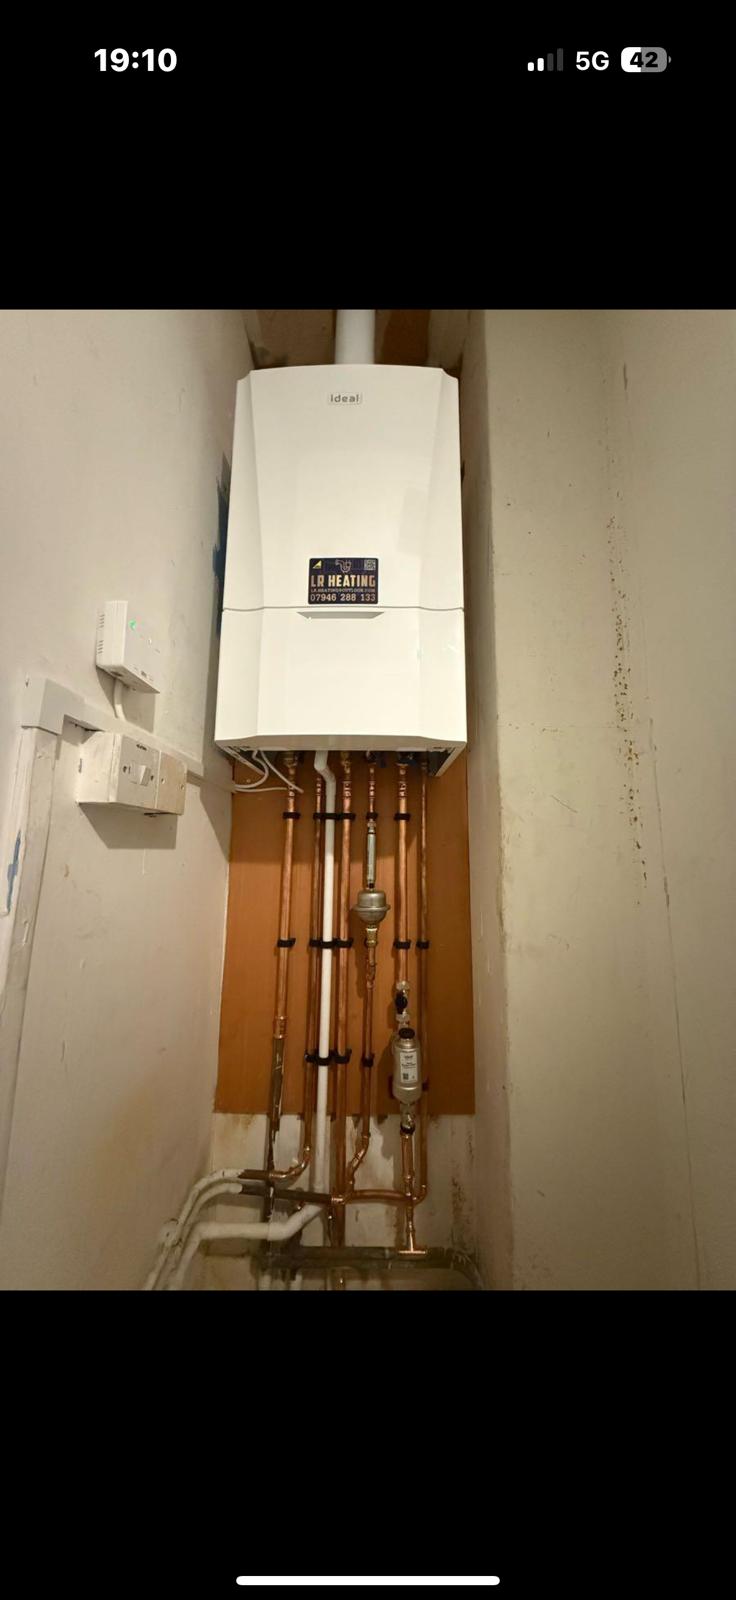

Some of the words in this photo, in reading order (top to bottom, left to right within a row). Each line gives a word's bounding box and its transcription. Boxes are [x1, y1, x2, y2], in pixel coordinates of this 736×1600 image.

[311, 575, 324, 587] LR
[328, 575, 376, 587] HEATING
[310, 593, 337, 601] 07946
[340, 593, 356, 601] 288
[361, 593, 376, 601] 133
